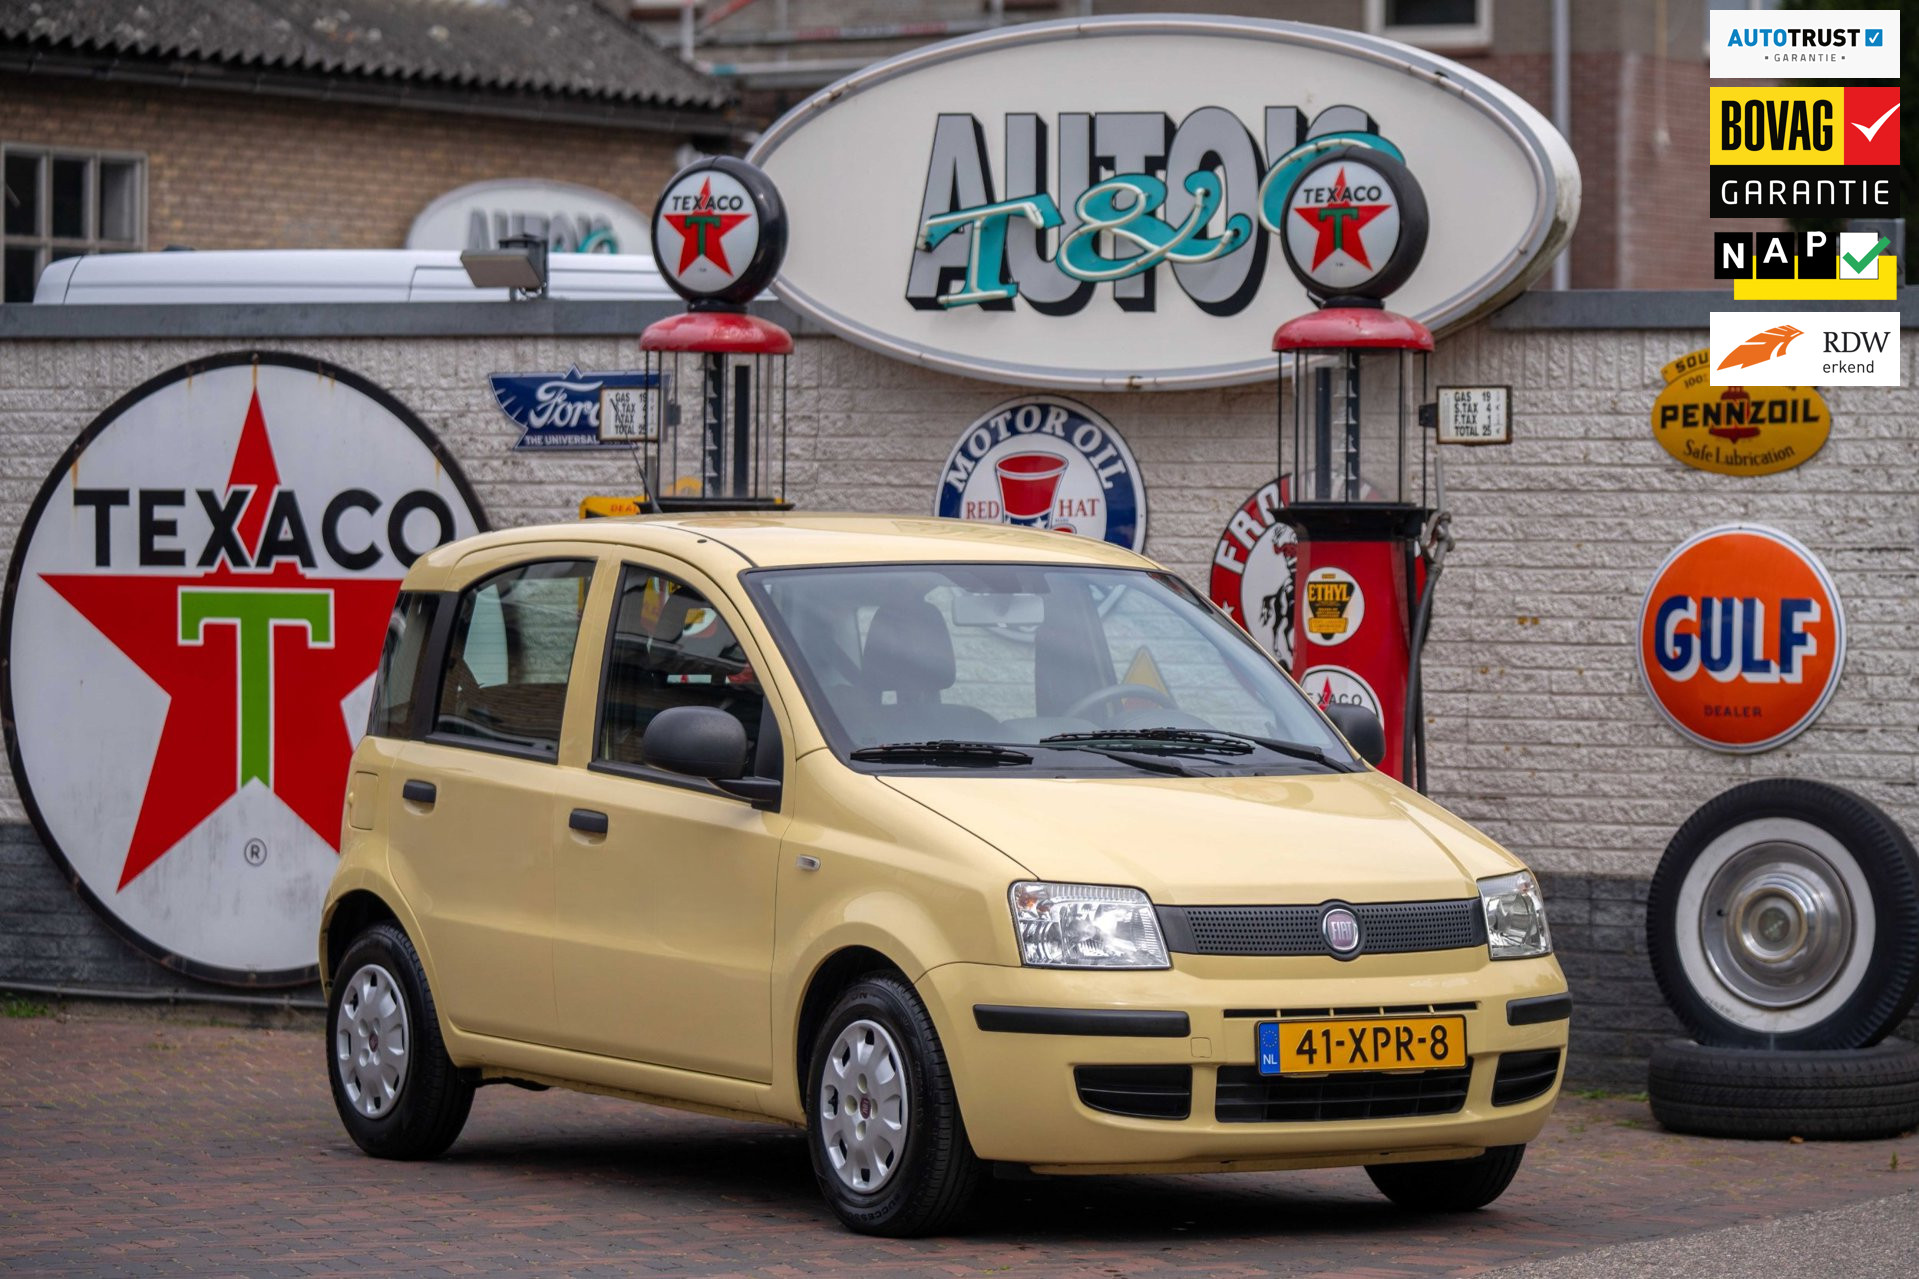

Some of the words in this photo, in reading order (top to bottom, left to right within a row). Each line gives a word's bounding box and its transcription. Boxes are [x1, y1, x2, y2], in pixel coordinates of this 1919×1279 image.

[673, 195, 743, 211] TEXACO
[1304, 186, 1382, 204] TEXACO
[905, 104, 1381, 317] AUTO'
[1675, 351, 1709, 373] SOU
[1454, 391, 1472, 402] GAS
[1482, 391, 1491, 402] 19
[1454, 402, 1478, 413] S.TAX
[1486, 403, 1491, 412] 4
[1660, 399, 1820, 429] PENNZOIL
[1454, 414, 1477, 424] F.TAX
[525, 435, 543, 445] THE
[545, 435, 599, 445] UNIVERSAL
[1454, 426, 1479, 436] TOTAL
[1482, 425, 1491, 436] 25
[947, 405, 1069, 493] MOTOR
[1073, 424, 1126, 489] OIL
[1684, 439, 1712, 461] Safe
[1715, 445, 1796, 466] Lubrication
[966, 501, 999, 520] RED
[1059, 498, 1100, 517] HAT
[73, 488, 456, 570] TEXACO
[1308, 583, 1350, 602] ETHYL
[1655, 595, 1821, 684] GULF
[1704, 705, 1762, 717] DEALER
[1331, 921, 1352, 940] FIAT
[1296, 1025, 1449, 1064] 41-XPR-8
[1263, 1054, 1278, 1066] NL
